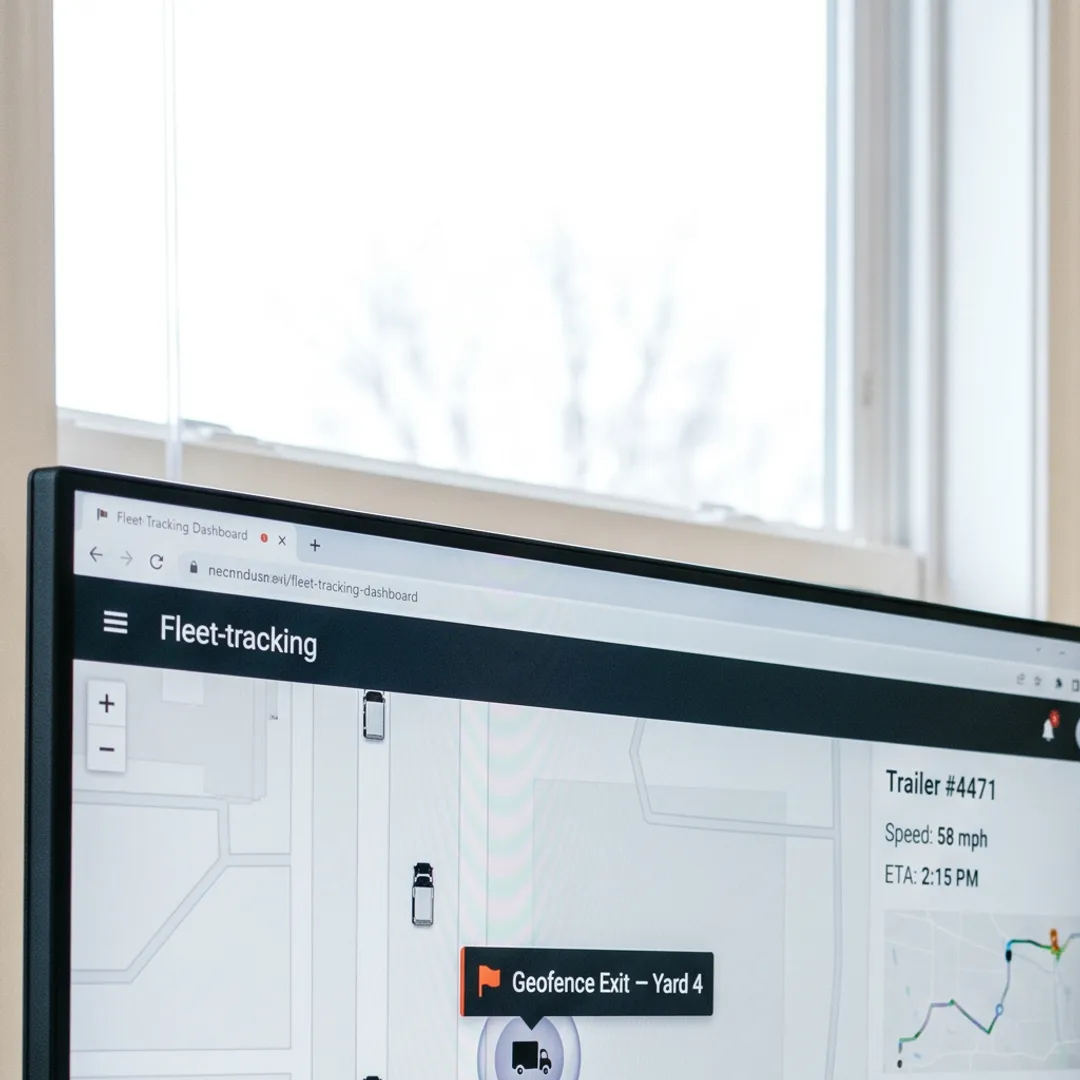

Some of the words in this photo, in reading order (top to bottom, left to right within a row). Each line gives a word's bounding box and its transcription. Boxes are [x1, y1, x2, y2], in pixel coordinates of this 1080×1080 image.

[116, 511, 144, 526] Fleet
[146, 515, 190, 535] Tracking
[193, 522, 248, 541] Dashboard
[160, 614, 318, 662] Fleet-tracking
[886, 769, 941, 796] Trailer
[945, 775, 996, 801] #4471
[885, 822, 933, 848] Speed:
[937, 826, 954, 847] 58
[958, 828, 988, 852] mph
[885, 864, 917, 885] ETA:
[921, 866, 952, 887] 2:15
[956, 869, 979, 888] PM
[512, 971, 595, 993] Geofence
[599, 972, 630, 994] Exit
[652, 973, 689, 994] Yard
[692, 974, 703, 994] 4
